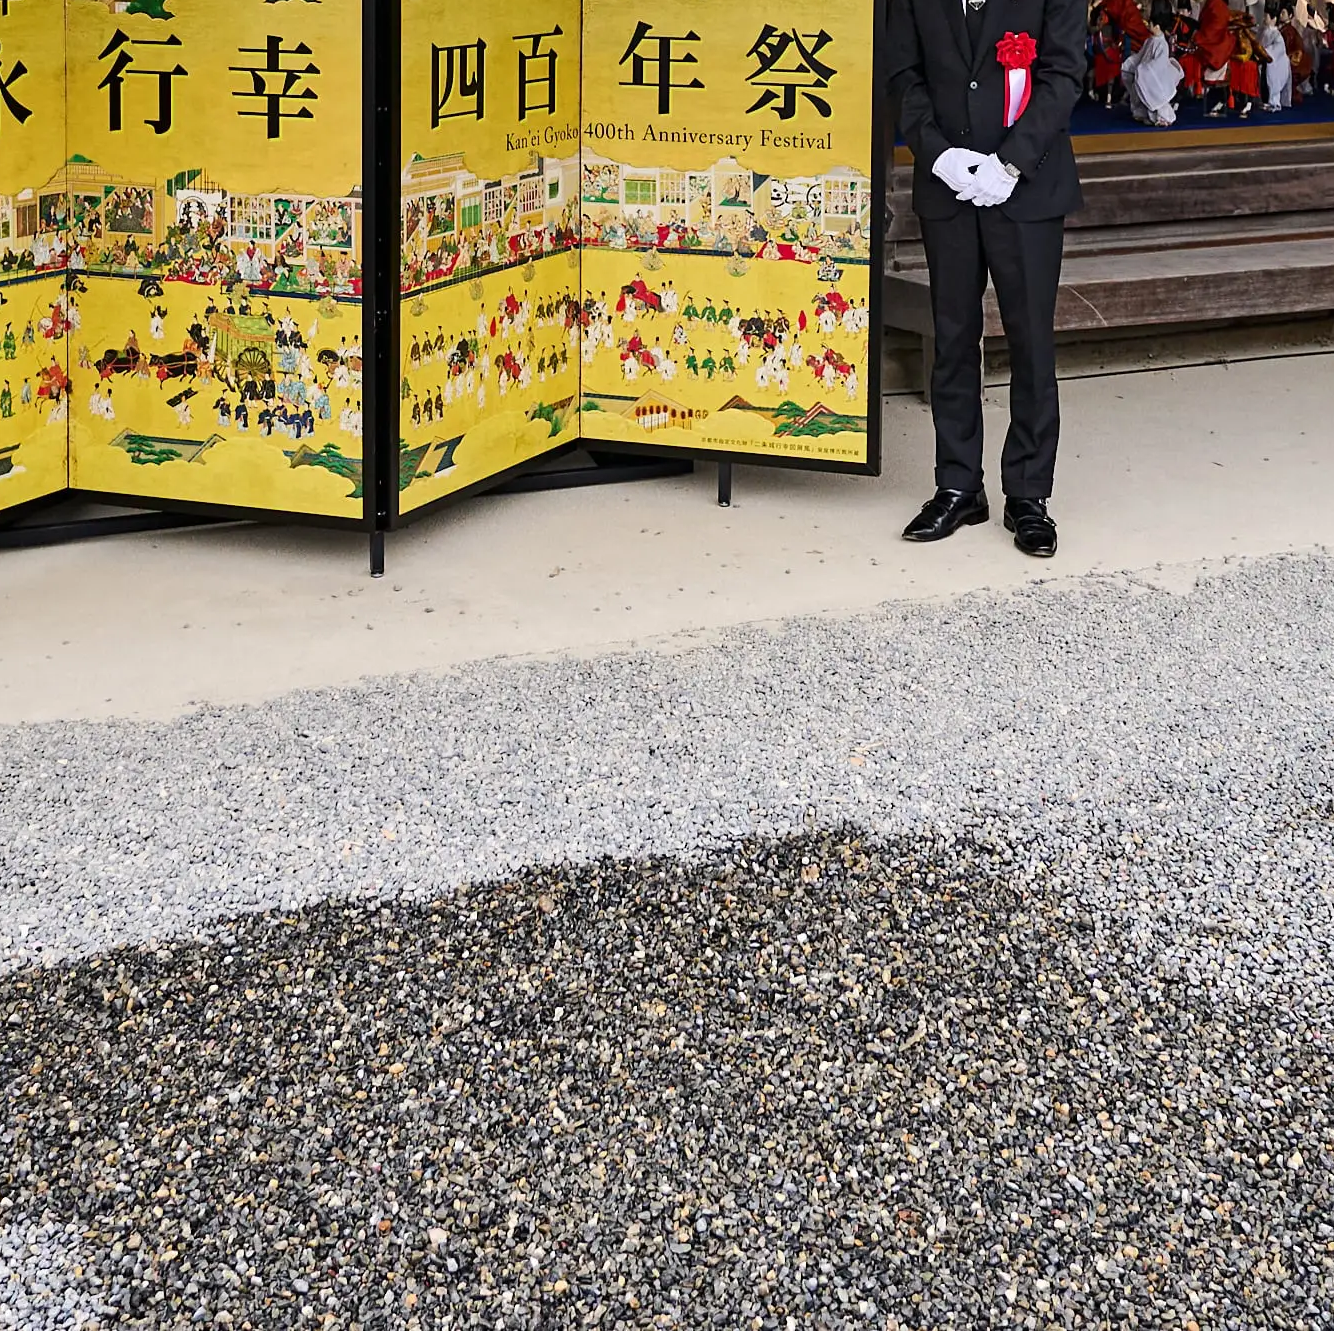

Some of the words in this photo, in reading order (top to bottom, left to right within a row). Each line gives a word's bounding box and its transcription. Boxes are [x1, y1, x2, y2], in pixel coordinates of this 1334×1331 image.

[506, 129, 540, 151] Kan'ei
[544, 127, 579, 149] Gyoko
[583, 122, 634, 141] 400th
[642, 124, 753, 152] Anniversary
[759, 129, 832, 150] Festival
